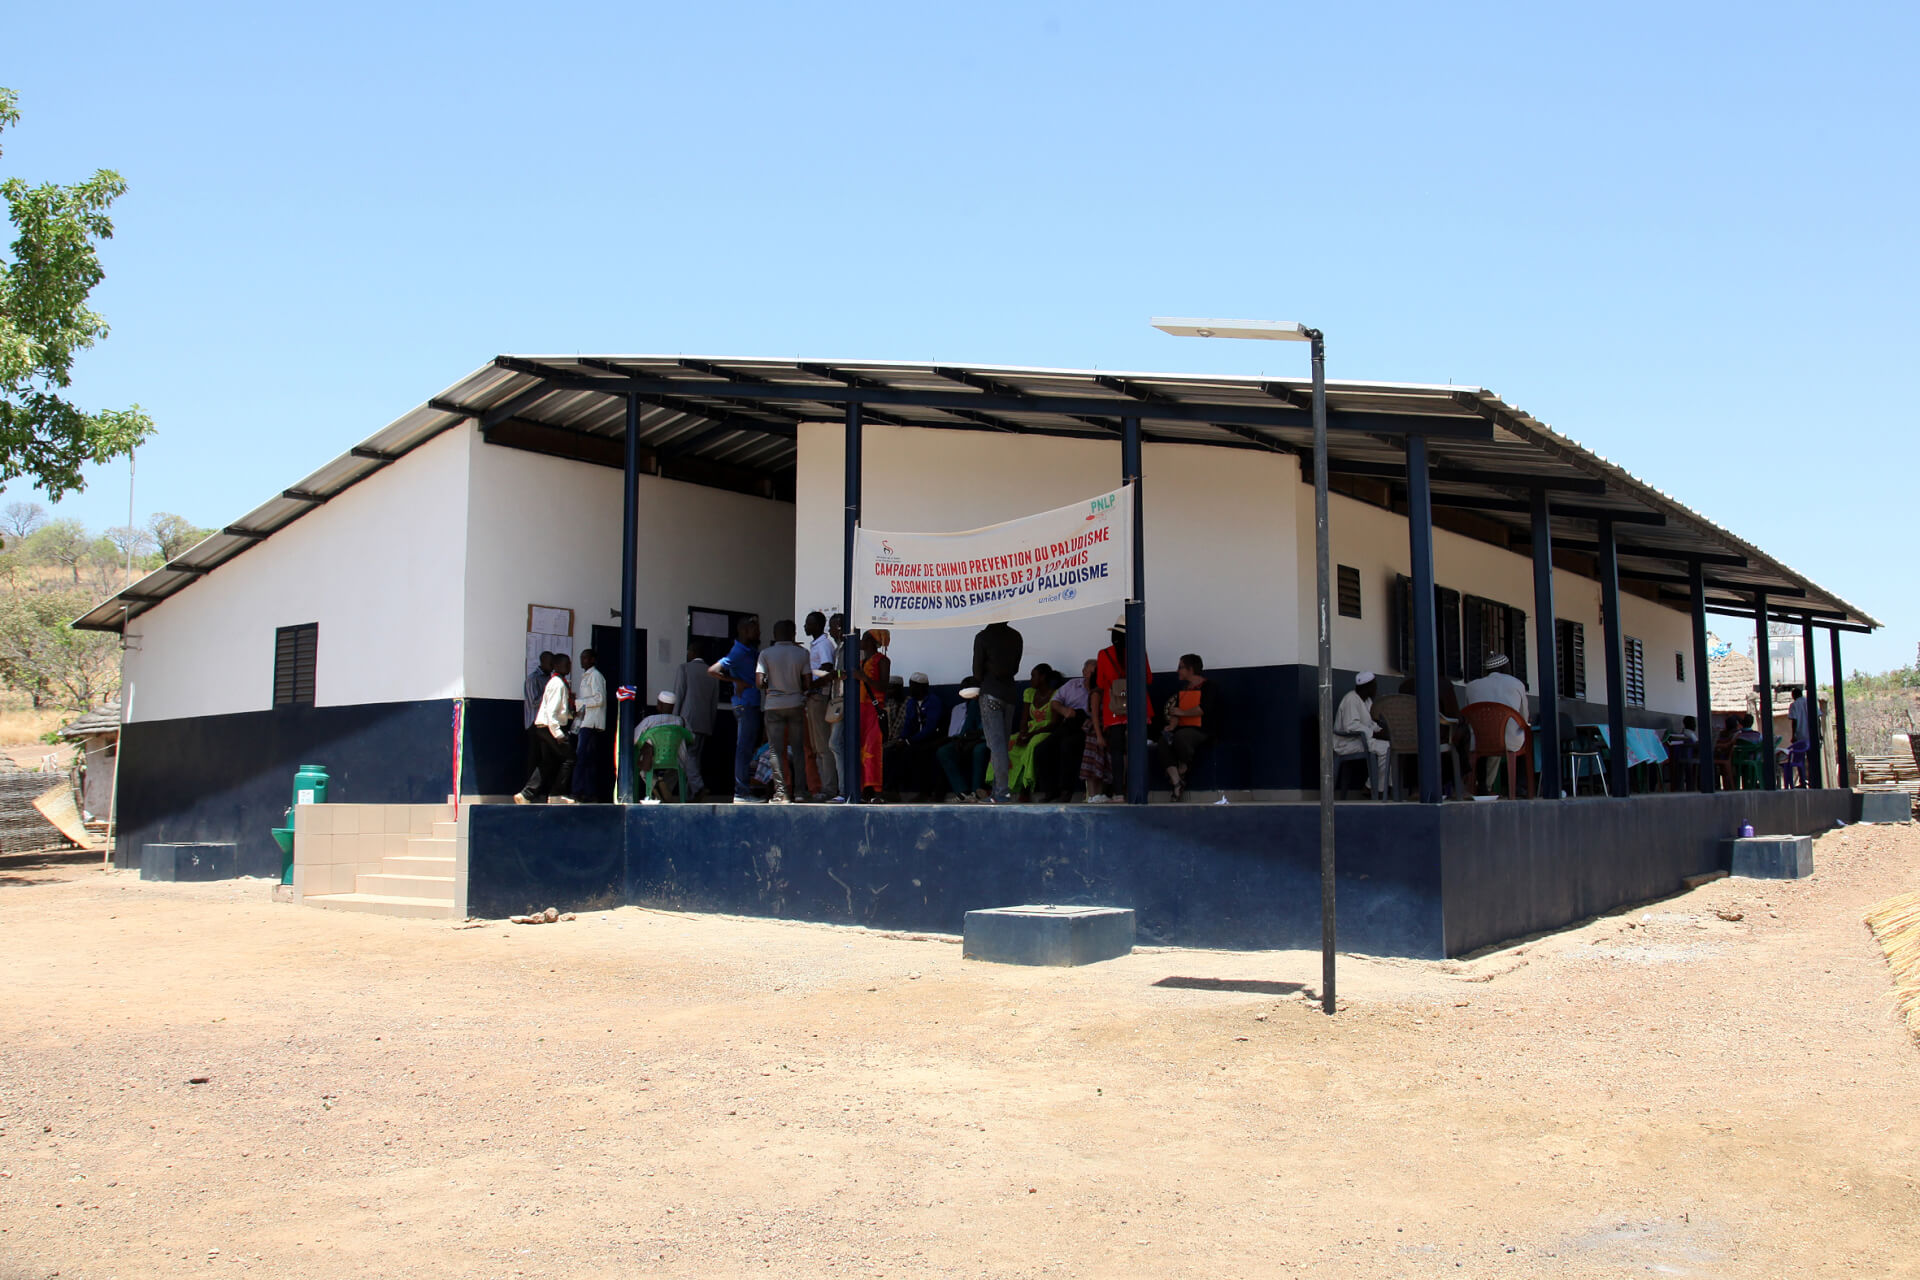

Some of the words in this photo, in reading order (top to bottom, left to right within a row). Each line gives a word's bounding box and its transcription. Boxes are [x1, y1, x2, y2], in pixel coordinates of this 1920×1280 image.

[1091, 494, 1116, 513] PNLP
[875, 562, 922, 576] CAMPAGNE
[924, 563, 934, 576] DE
[936, 561, 967, 576] CHIMIO
[969, 550, 1032, 574] PREVENTION
[1035, 546, 1048, 562] DU
[1050, 526, 1110, 558] PALUDISME
[874, 595, 942, 610] PROTEGEONS
[945, 594, 967, 608] NOS
[1018, 580, 1034, 596] DU
[1038, 562, 1108, 591] PALUDISME
[891, 580, 942, 594] SAISONNIER
[945, 579, 962, 592] AUX
[964, 573, 1009, 592] ENFANTS
[1011, 570, 1023, 585] DE
[1027, 568, 1032, 582] 3
[1038, 592, 1062, 604] unicef
